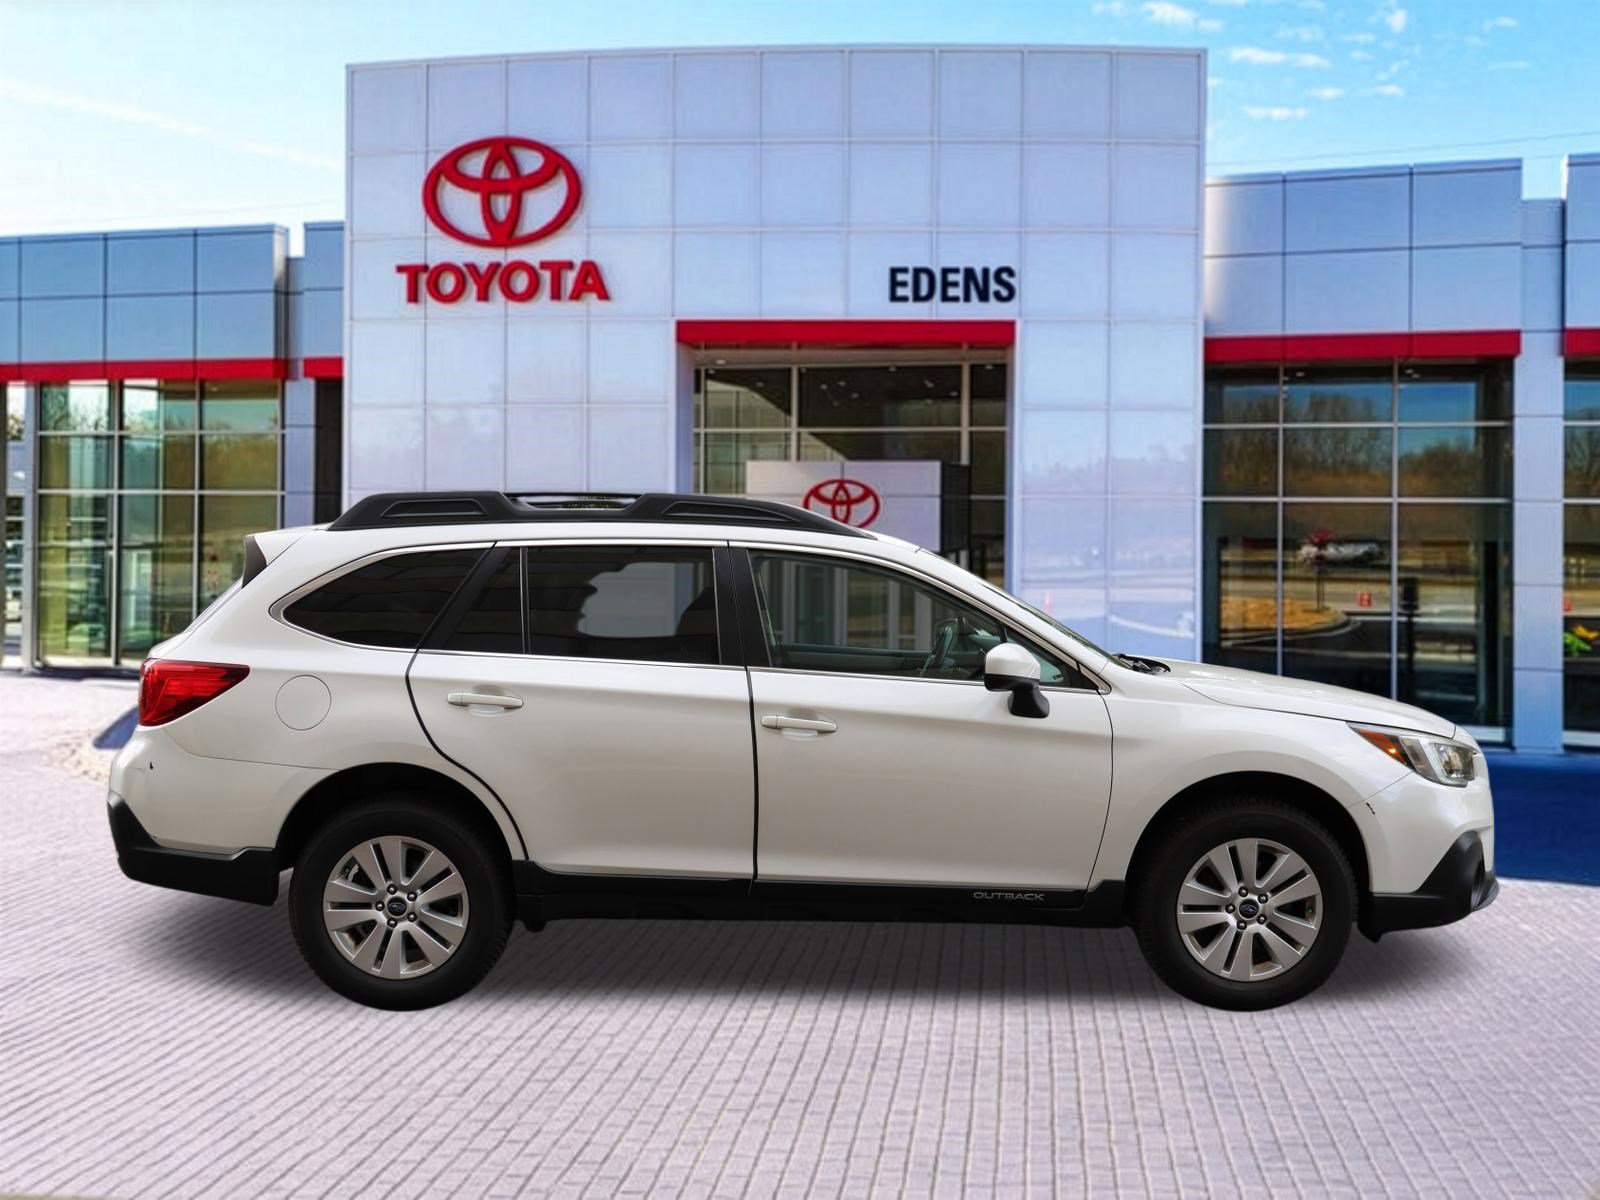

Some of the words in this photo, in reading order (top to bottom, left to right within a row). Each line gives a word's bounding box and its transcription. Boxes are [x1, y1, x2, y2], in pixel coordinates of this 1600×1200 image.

[396, 260, 611, 304] TOYOTA
[889, 266, 1016, 303] EDENS
[973, 891, 1045, 901] OUTBACK
